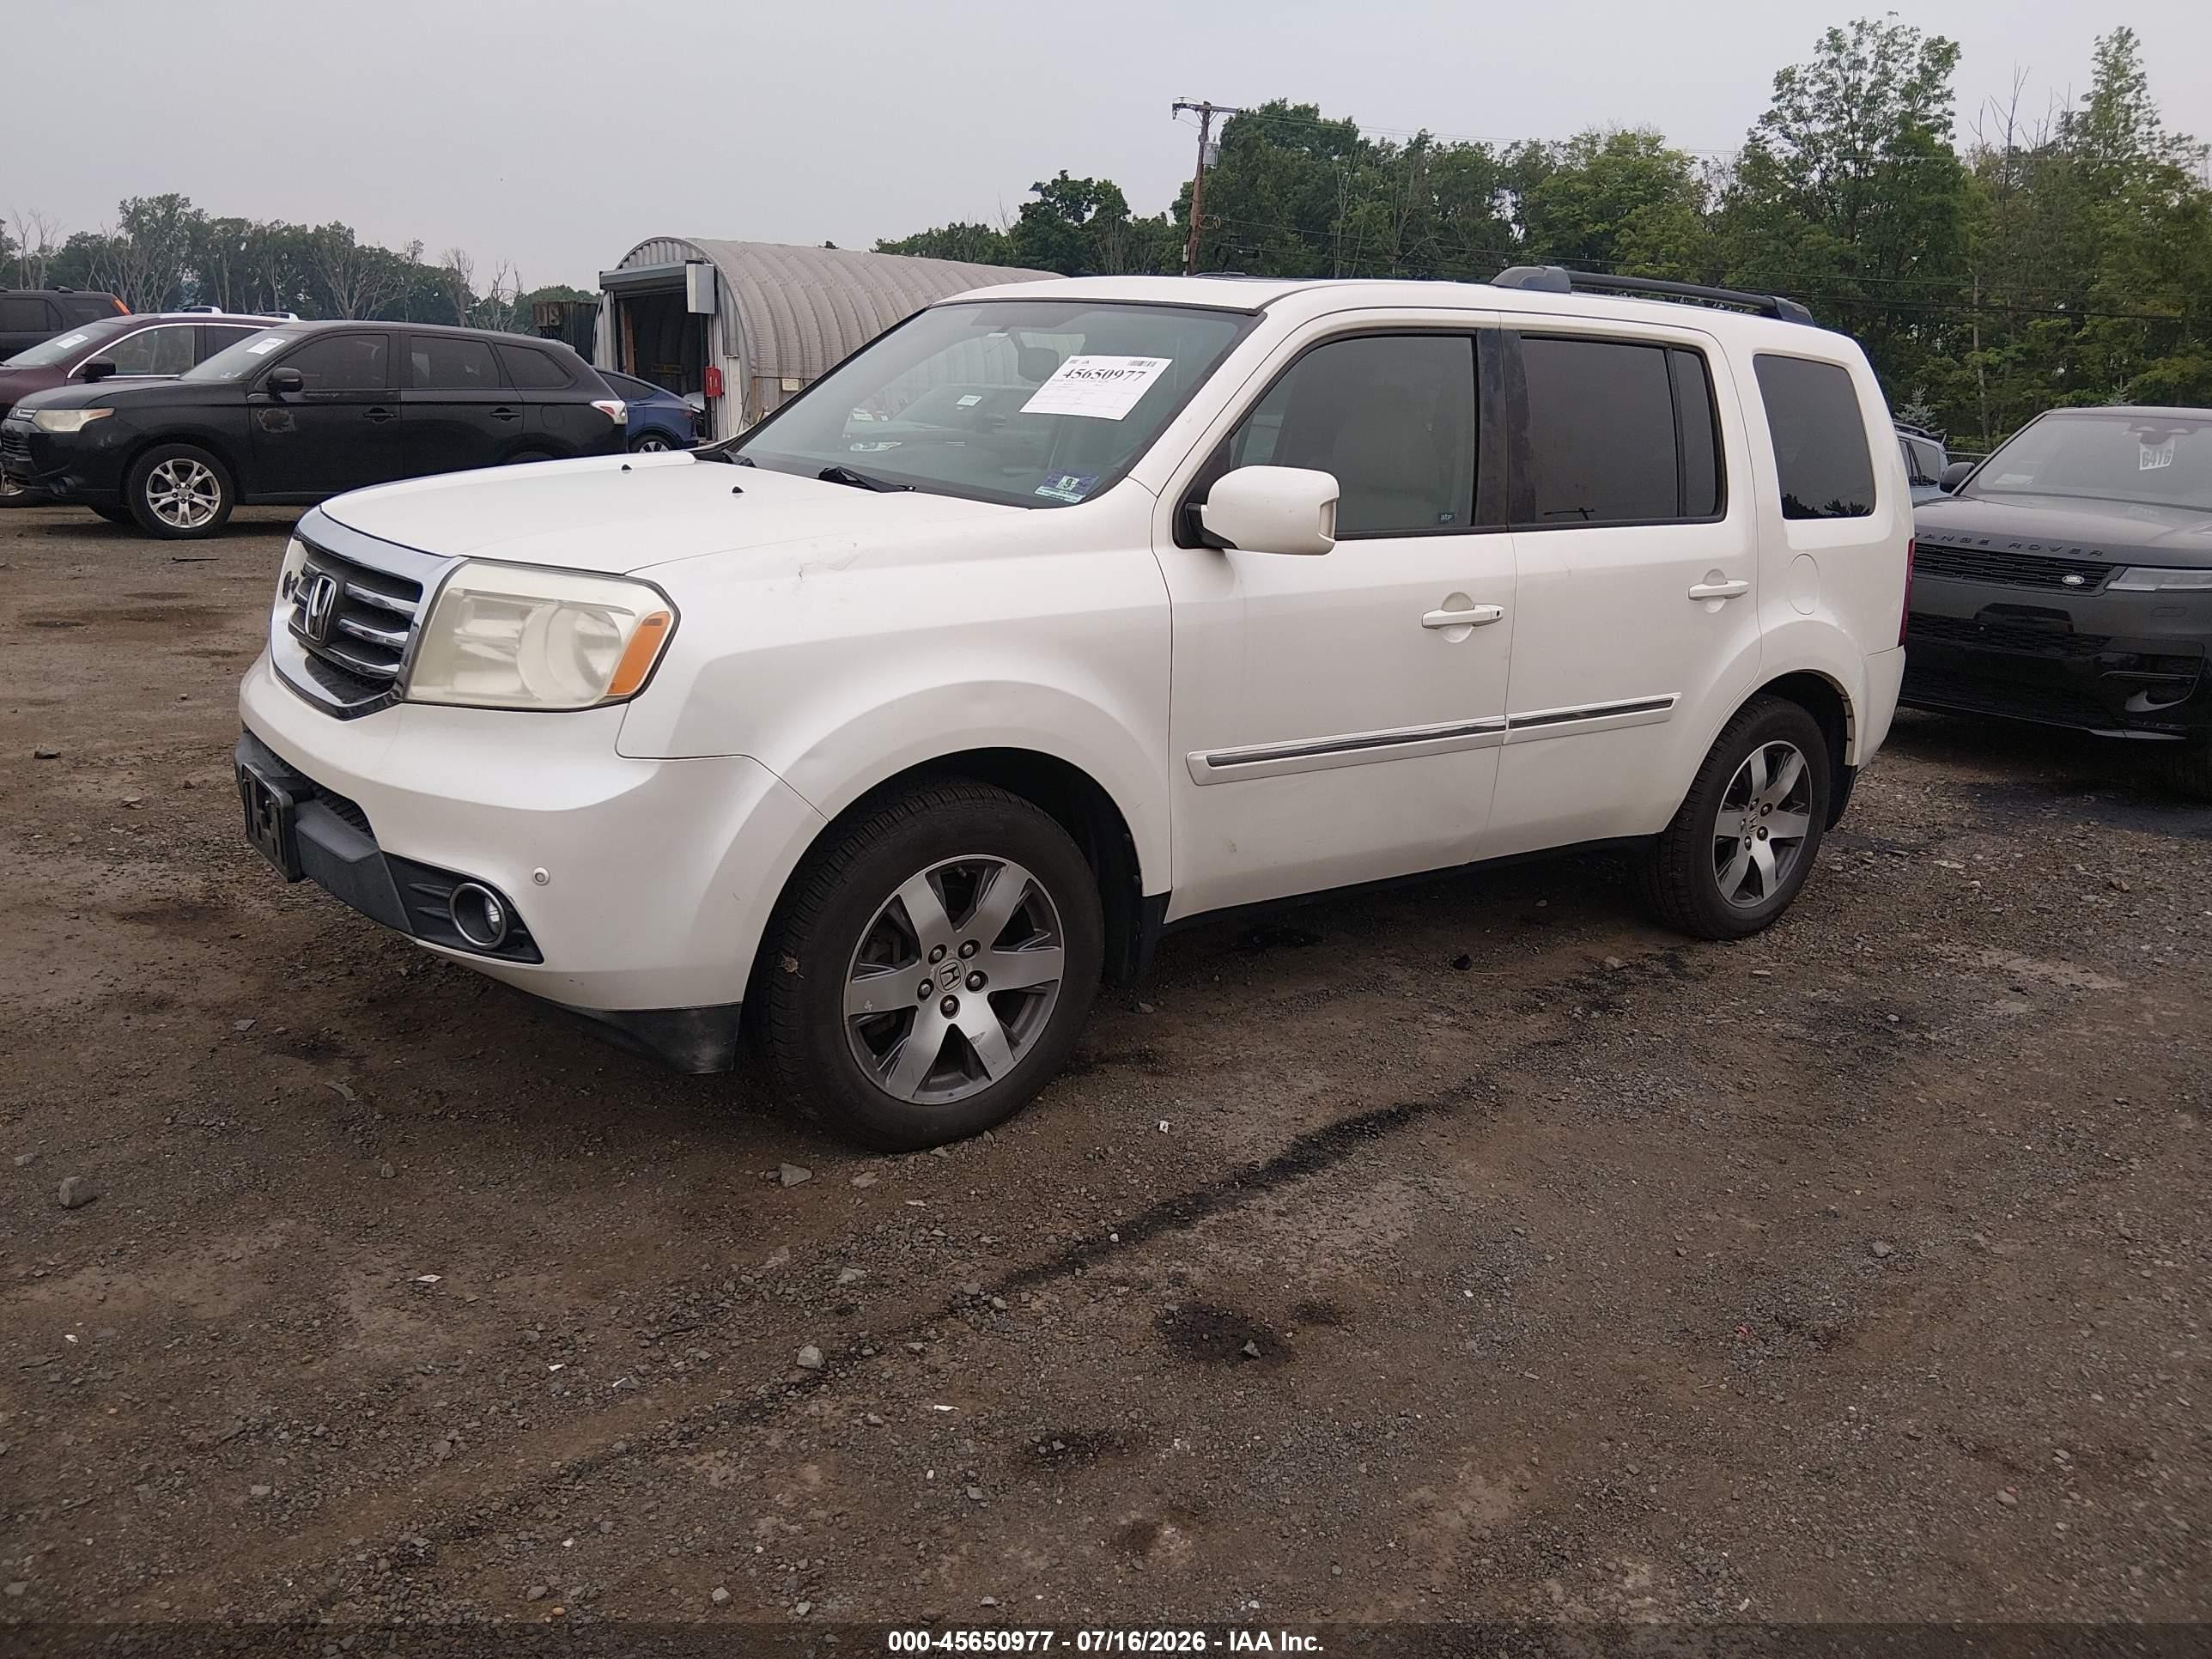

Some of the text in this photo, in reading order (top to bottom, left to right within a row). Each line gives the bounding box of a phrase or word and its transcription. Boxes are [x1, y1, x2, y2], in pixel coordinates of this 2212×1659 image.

[1062, 368, 1147, 381] 45650977
[2142, 448, 2172, 468] 6416
[2008, 542, 2104, 556] ROVER
